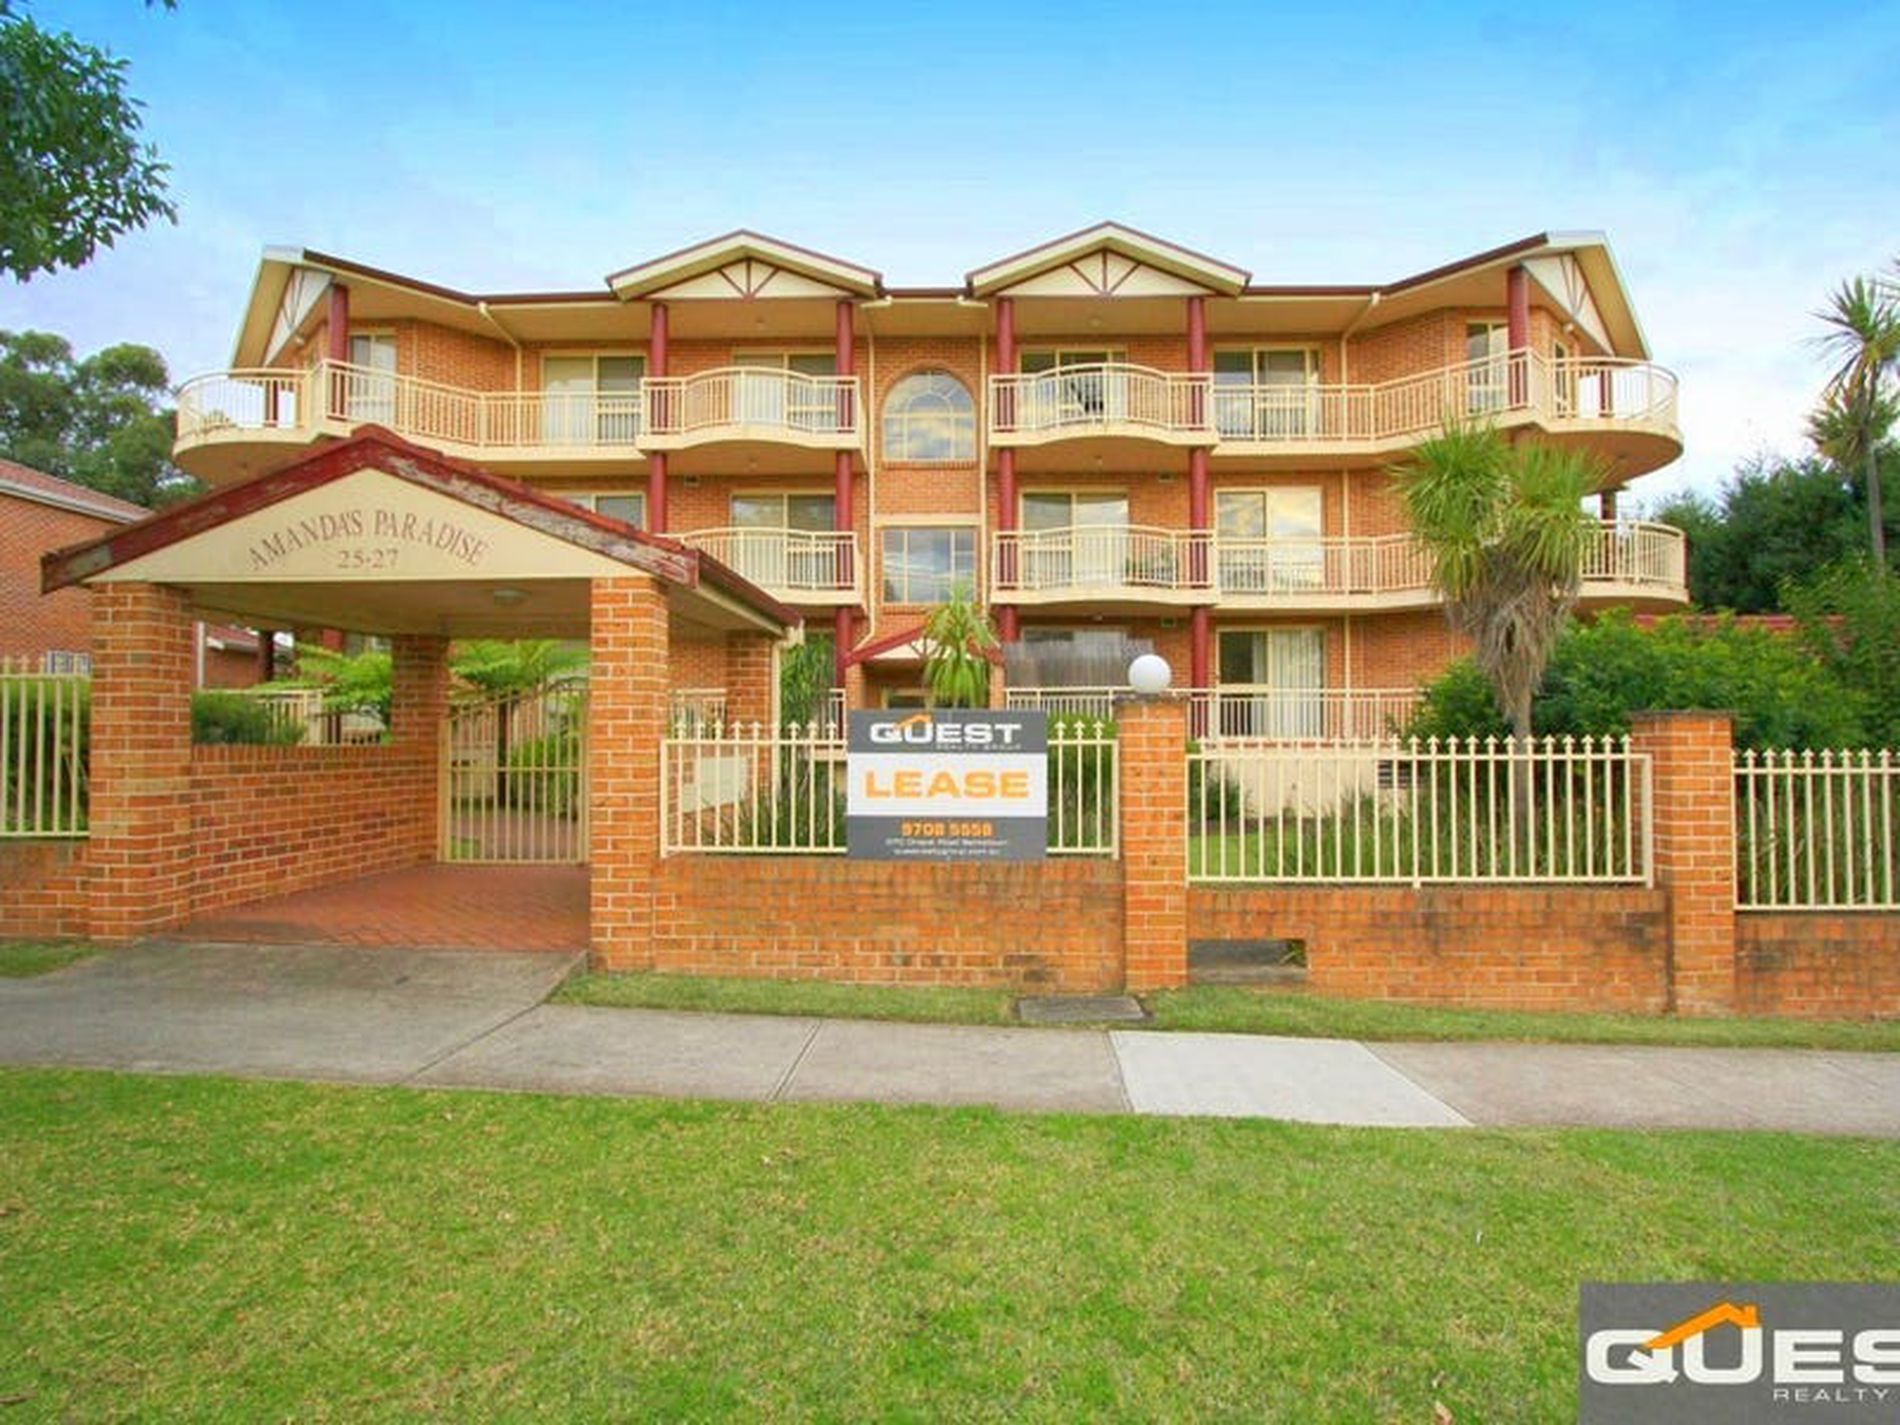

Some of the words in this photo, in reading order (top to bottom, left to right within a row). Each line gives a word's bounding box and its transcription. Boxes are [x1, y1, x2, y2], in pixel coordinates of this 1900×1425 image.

[249, 510, 364, 571] AMANDA'S
[374, 509, 489, 567] PARADISE
[338, 550, 399, 569] 25-27
[870, 720, 1022, 743] QUEST
[865, 770, 1029, 799] LEASE
